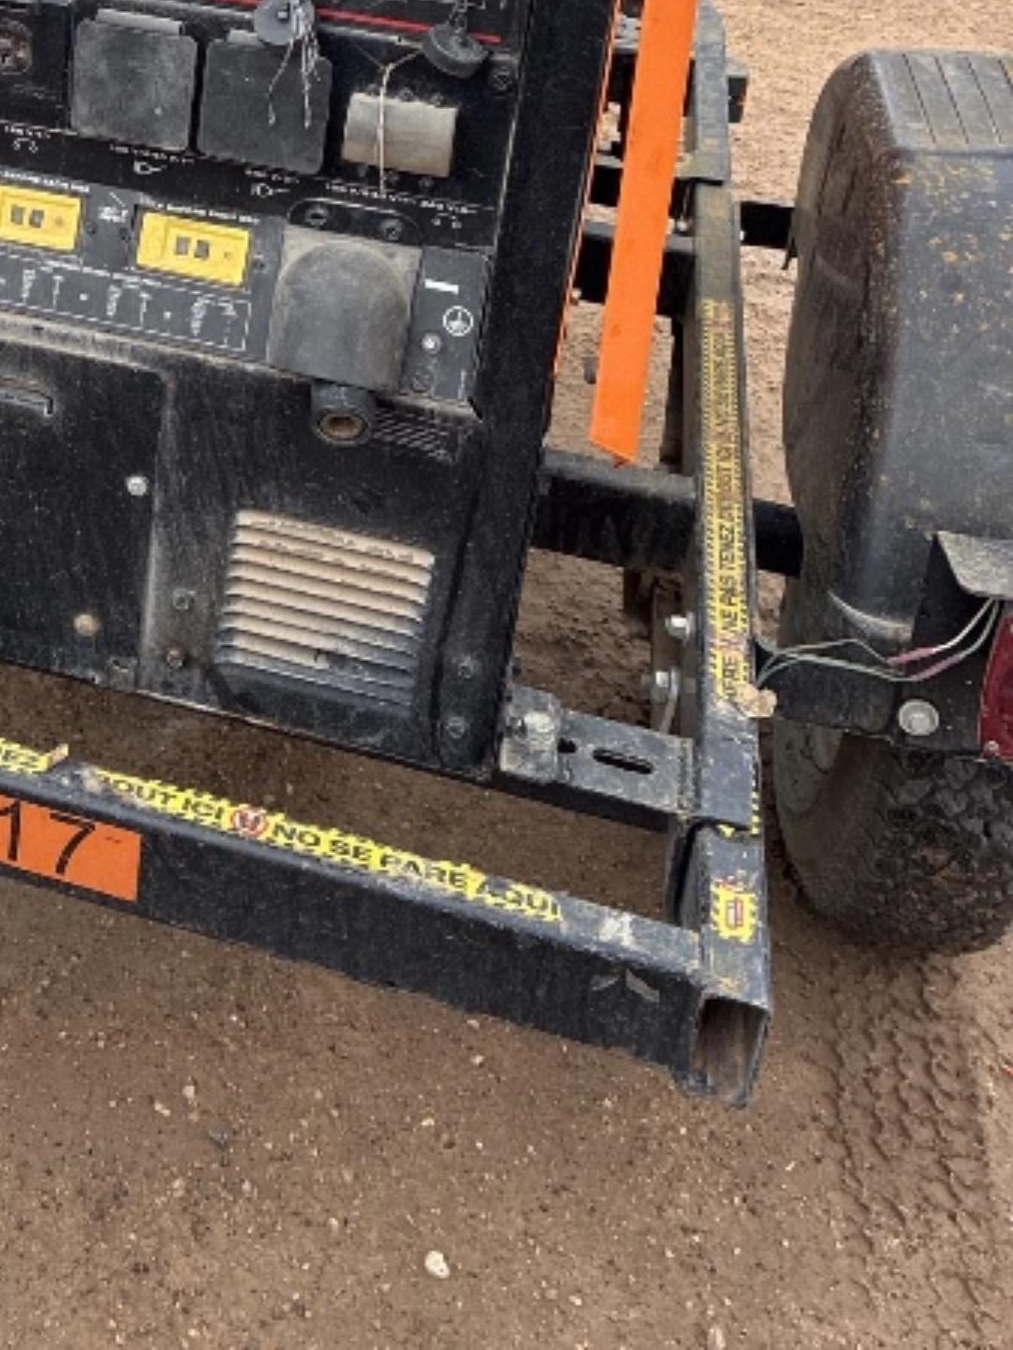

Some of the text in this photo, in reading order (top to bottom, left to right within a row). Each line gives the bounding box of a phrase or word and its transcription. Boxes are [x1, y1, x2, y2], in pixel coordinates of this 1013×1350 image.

[271, 822, 322, 848] NO
[329, 837, 373, 862] SE
[379, 852, 469, 890] PARE
